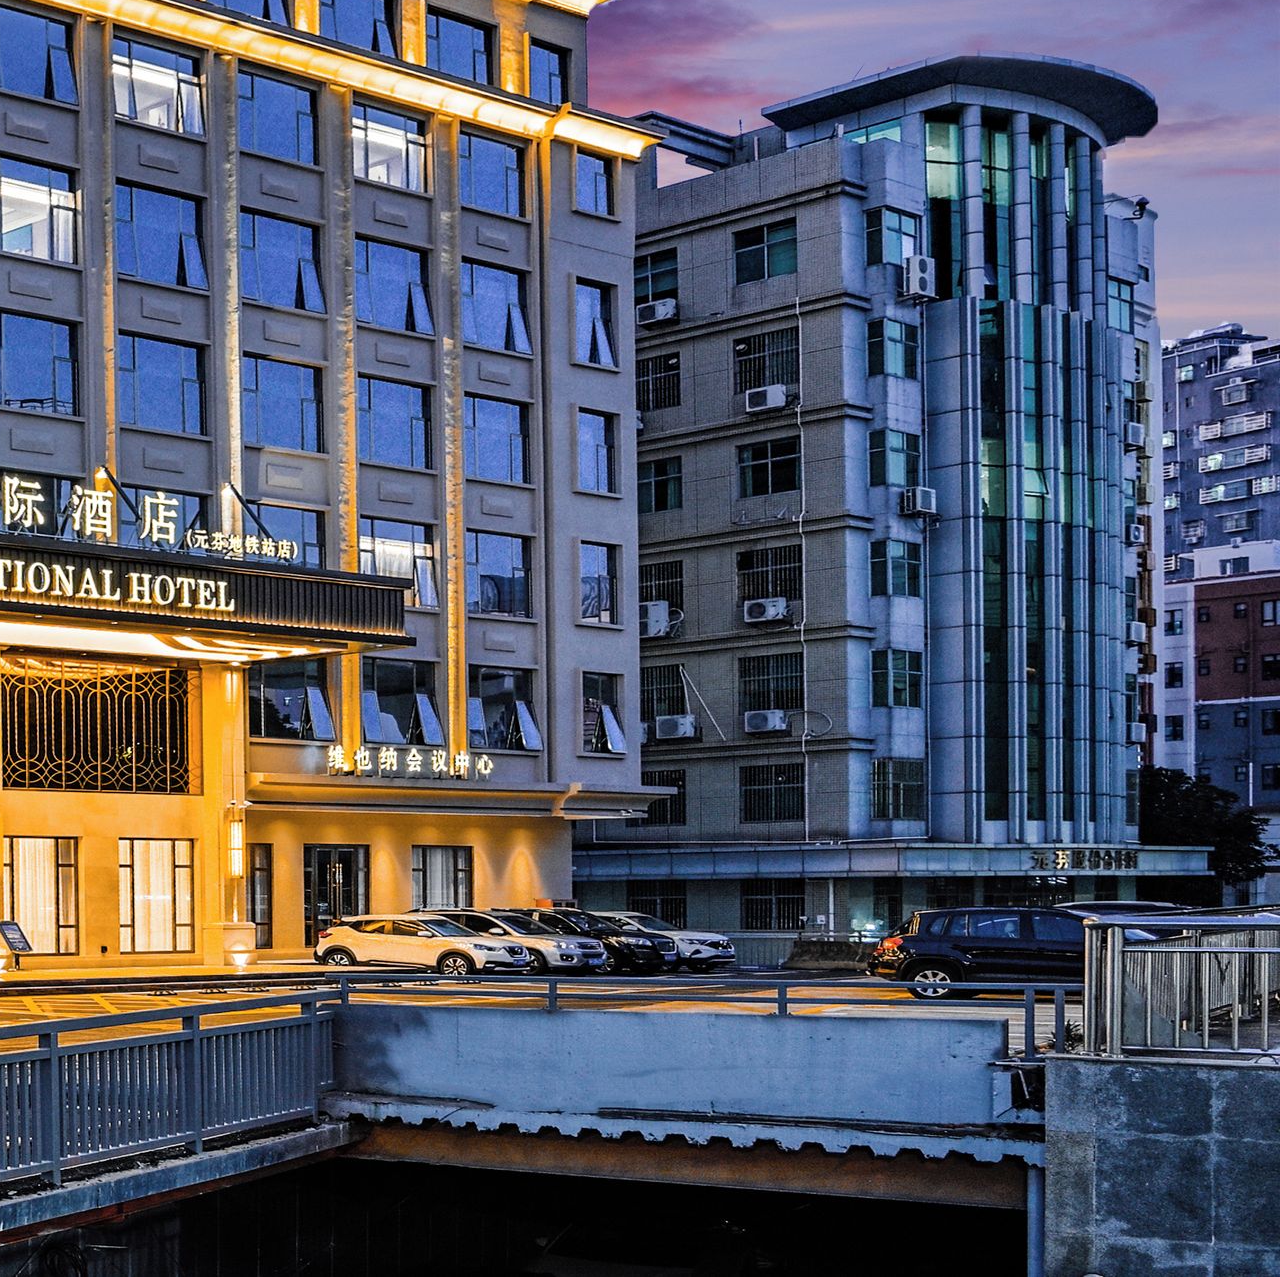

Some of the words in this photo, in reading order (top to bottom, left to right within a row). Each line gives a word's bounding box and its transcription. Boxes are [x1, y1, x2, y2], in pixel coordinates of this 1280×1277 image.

[125, 571, 235, 612] HOTEL
[328, 744, 494, 774] 维也纳会议中心
